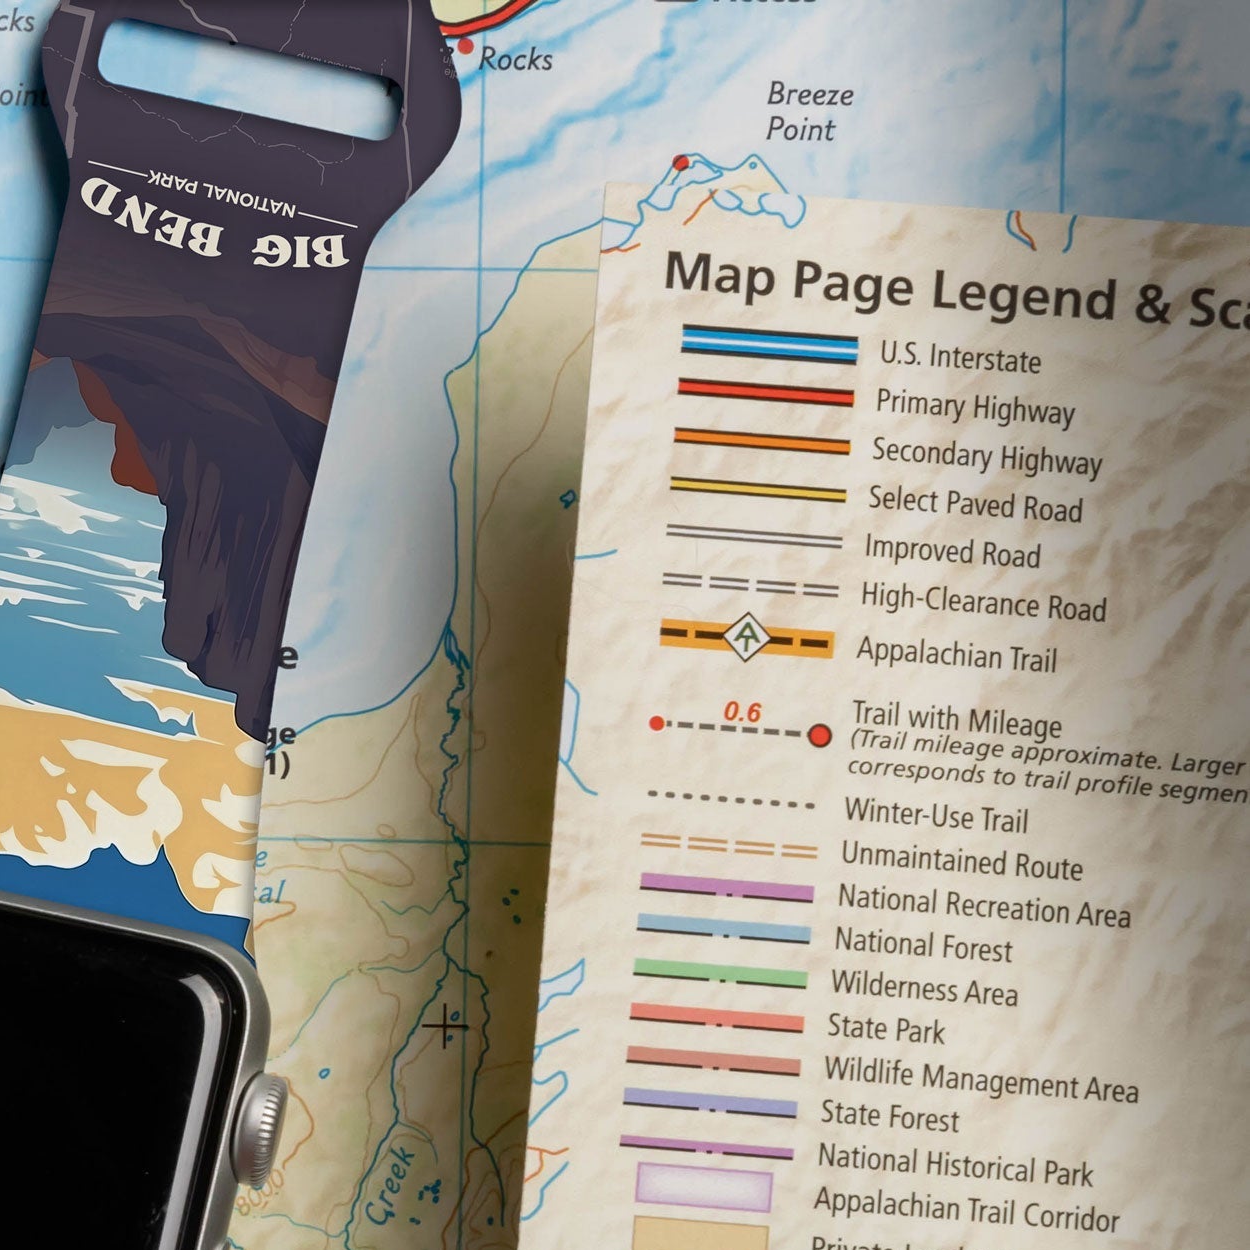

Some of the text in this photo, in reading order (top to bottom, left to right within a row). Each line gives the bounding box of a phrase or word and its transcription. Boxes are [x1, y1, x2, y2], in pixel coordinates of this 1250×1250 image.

[479, 48, 553, 73] Rocks
[767, 81, 854, 107] Breeze
[766, 117, 837, 143] Point
[149, 169, 296, 219] NATIONAL PARK
[80, 176, 351, 269] BIG BEND
[666, 251, 1171, 325] Map Page Legend &
[882, 340, 1041, 374] U.S. Interstate
[878, 388, 1075, 431] Primary Highway
[873, 437, 1103, 482] Secondary Highway
[870, 485, 1083, 523] Select Paved Road
[866, 533, 1041, 568] Improved Road
[863, 582, 1107, 622] High-Clearance Road
[857, 636, 1057, 673] Appalachian Trail
[724, 699, 762, 724] 0.6
[853, 700, 1062, 744] Trail with Mileage
[851, 728, 1246, 779] (Trail mileage approximate. Larger
[849, 761, 1152, 796] corresponds to trail profile
[846, 797, 1028, 833] Winter-Use Trail
[843, 840, 1083, 881] Unmaintained Route
[839, 883, 1131, 928] National Recreation Area
[836, 926, 1013, 962] National Forest
[832, 969, 1017, 1006] Wilderness Area
[828, 1013, 945, 1044] State Park
[825, 1056, 1138, 1103] Wildlife Management Area
[822, 1099, 959, 1133] State Forest
[819, 1143, 1093, 1187] National Historical Park
[814, 1186, 1120, 1232] Appalachian Trail Corridor
